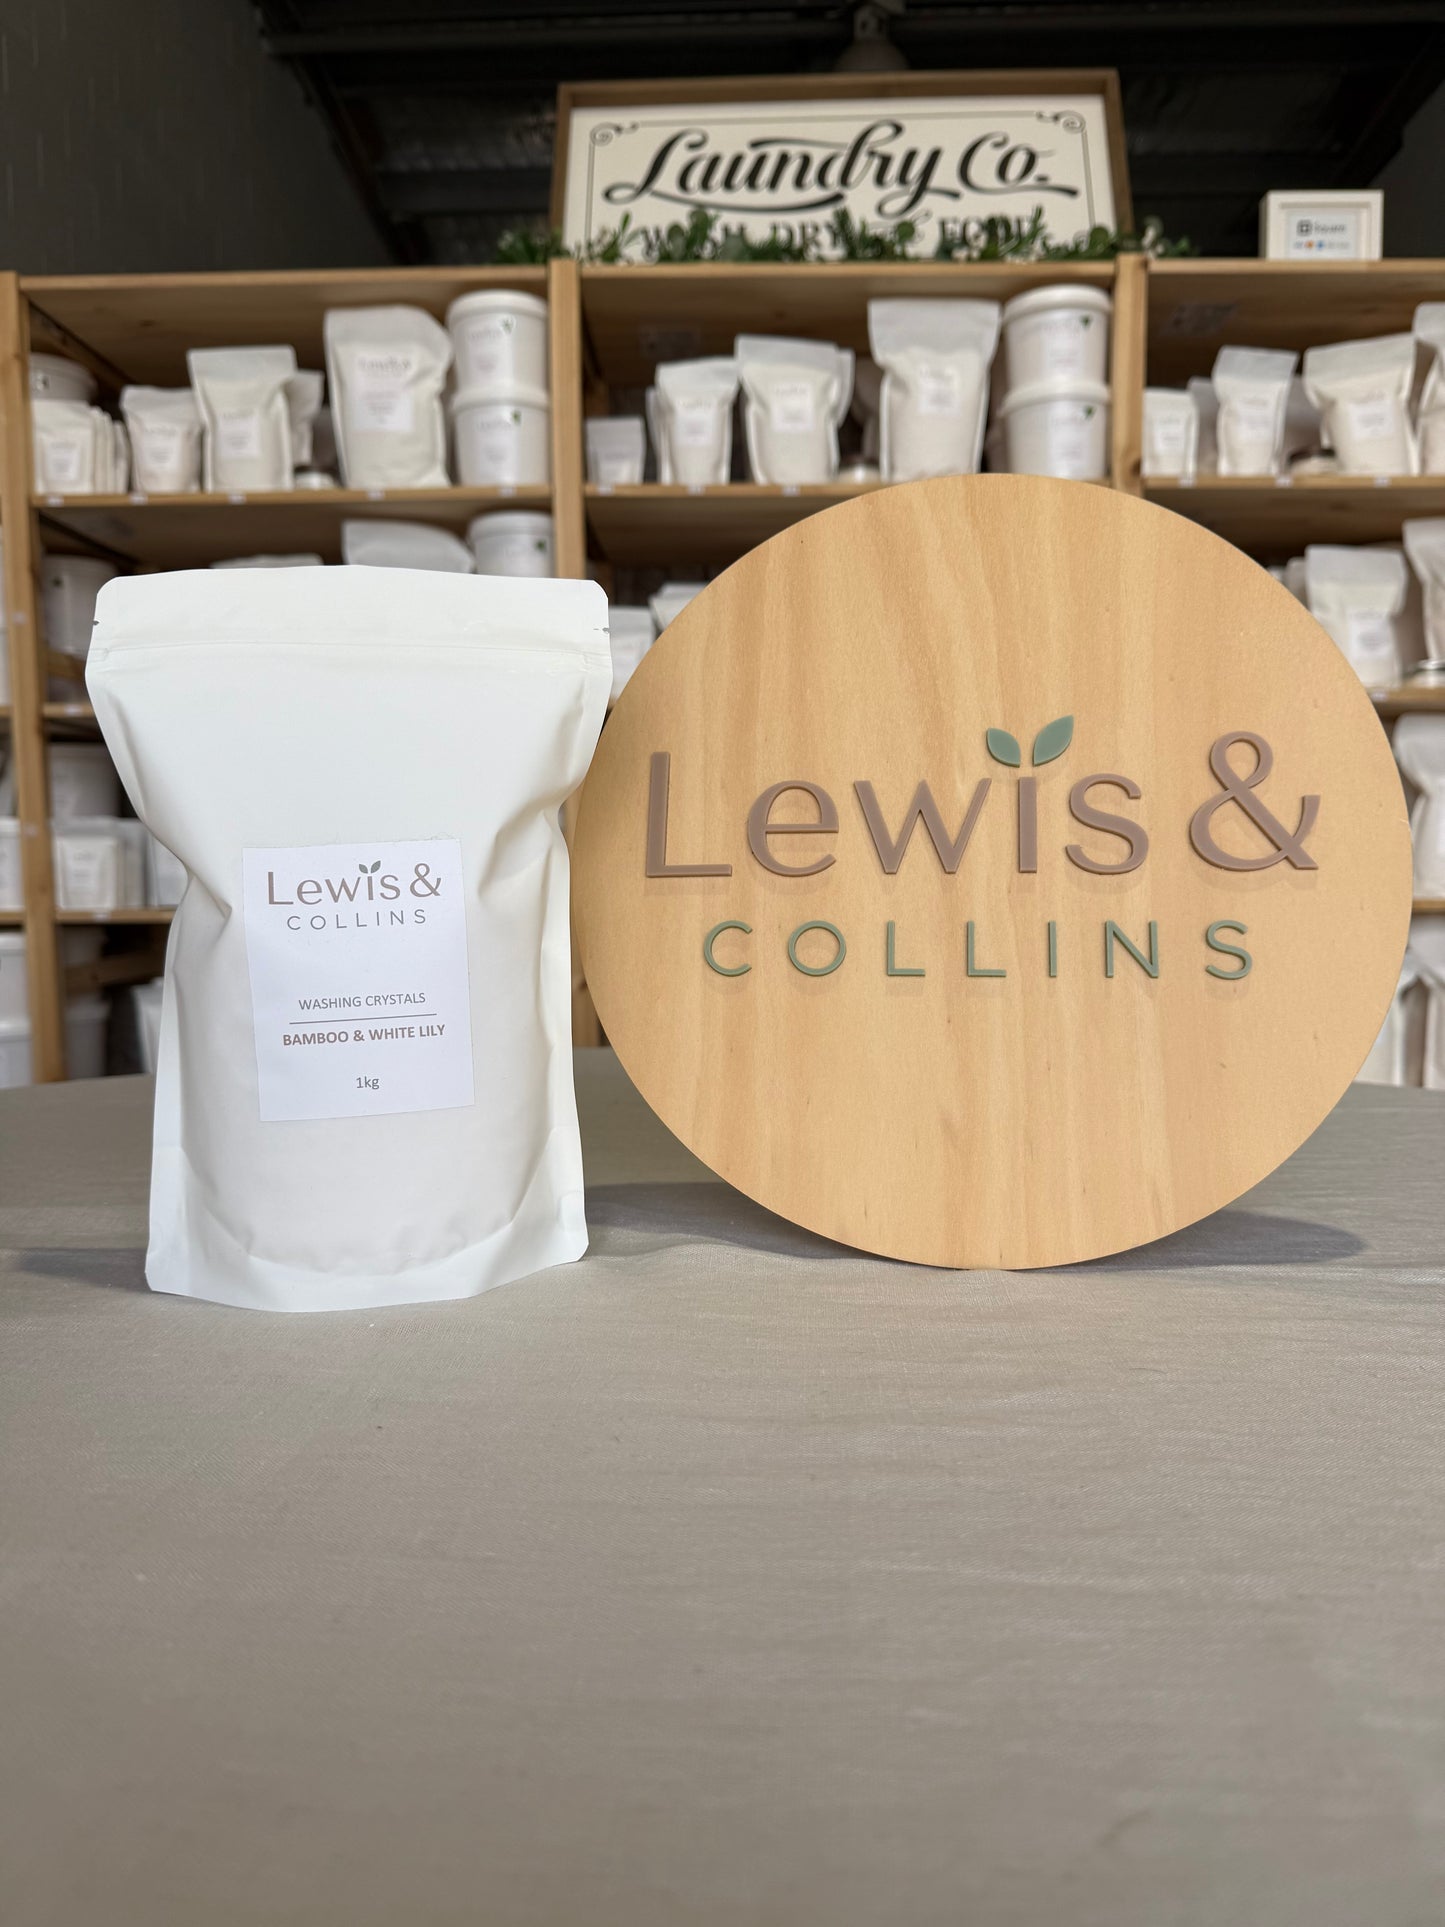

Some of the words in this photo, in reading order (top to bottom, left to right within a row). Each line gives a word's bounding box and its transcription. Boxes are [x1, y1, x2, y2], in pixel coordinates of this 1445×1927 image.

[604, 119, 959, 218] Laundry
[957, 131, 1079, 196] Co.
[645, 738, 1150, 878] Lewis
[1188, 730, 1322, 873] &
[267, 866, 401, 906] Lewis
[409, 862, 442, 898] &
[286, 908, 426, 931] COLLINS
[703, 919, 1254, 980] COLLINS
[298, 995, 362, 1011] WASHING
[364, 992, 426, 1007] CRYSTALS
[283, 1030, 349, 1046] BAMBOO
[352, 1029, 365, 1042] &
[368, 1026, 415, 1041] WHITE
[418, 1024, 446, 1038] LILY
[355, 1075, 380, 1090] 1kg
